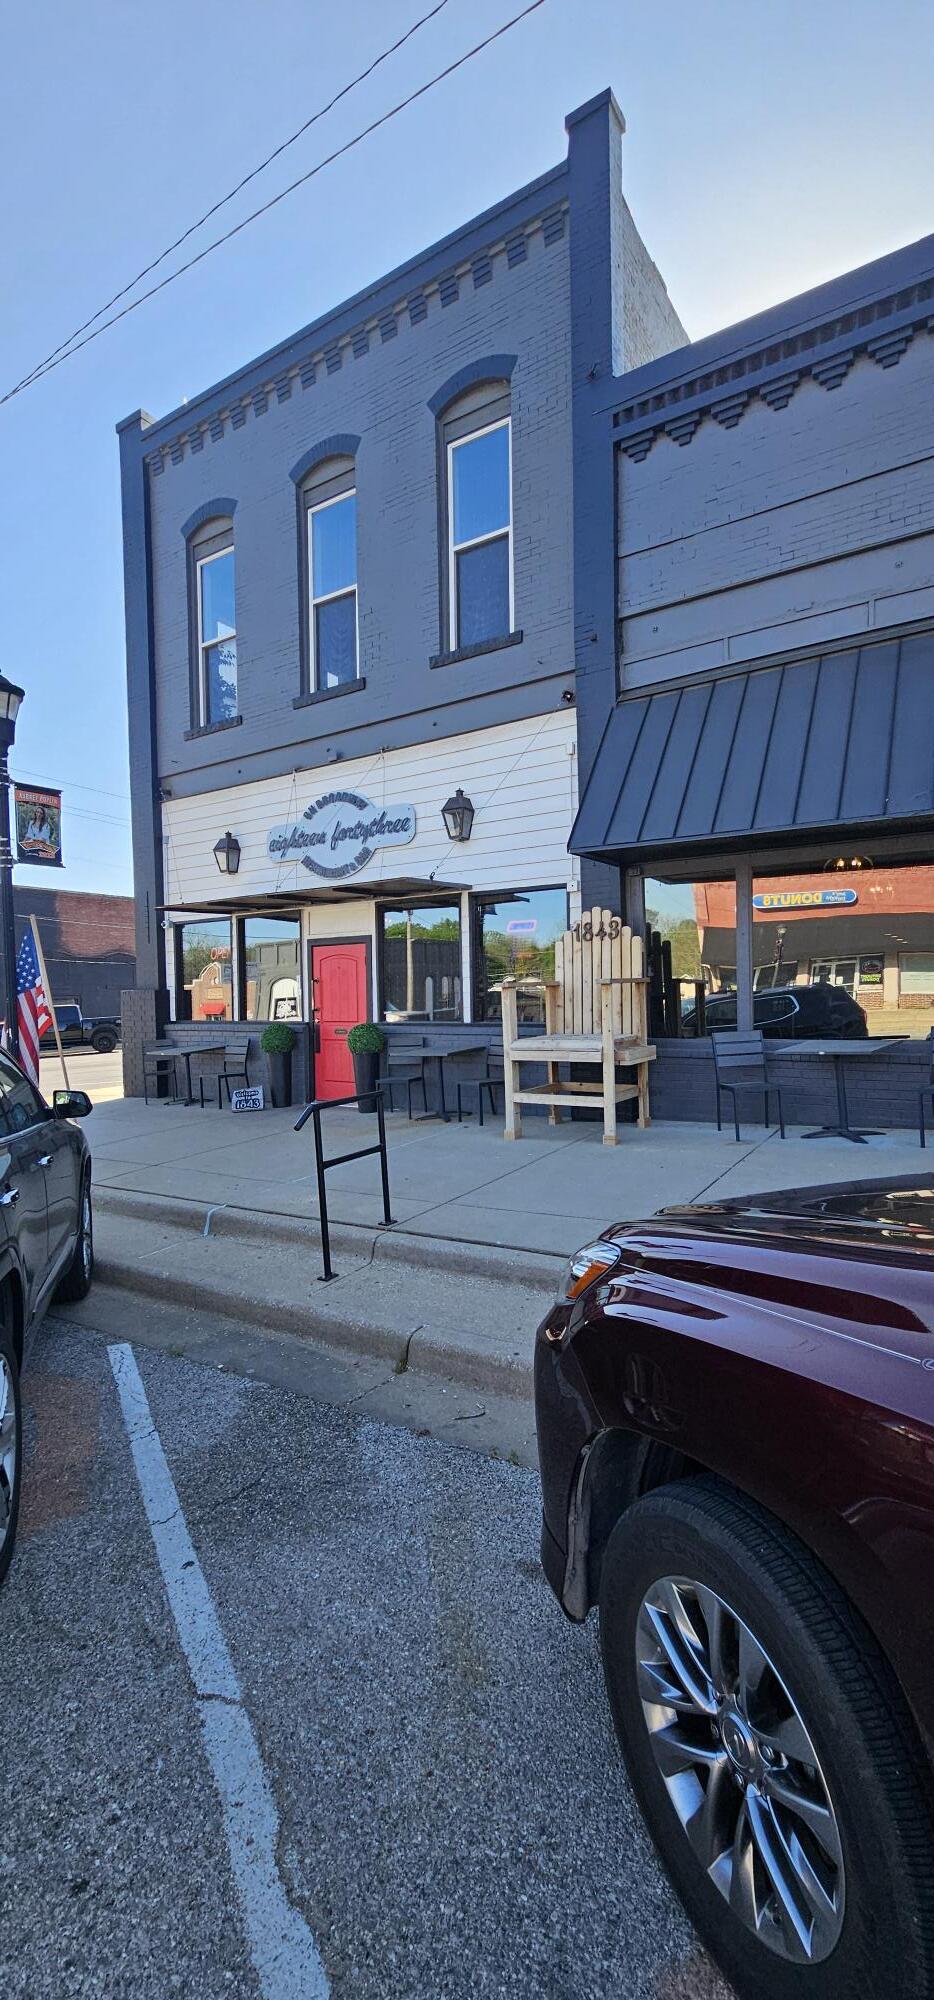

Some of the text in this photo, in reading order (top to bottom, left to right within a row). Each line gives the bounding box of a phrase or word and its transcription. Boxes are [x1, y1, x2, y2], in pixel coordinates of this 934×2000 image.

[269, 811, 411, 858] eighteen fortythree
[573, 920, 620, 942] 1843
[236, 1099, 260, 1109] 1843
